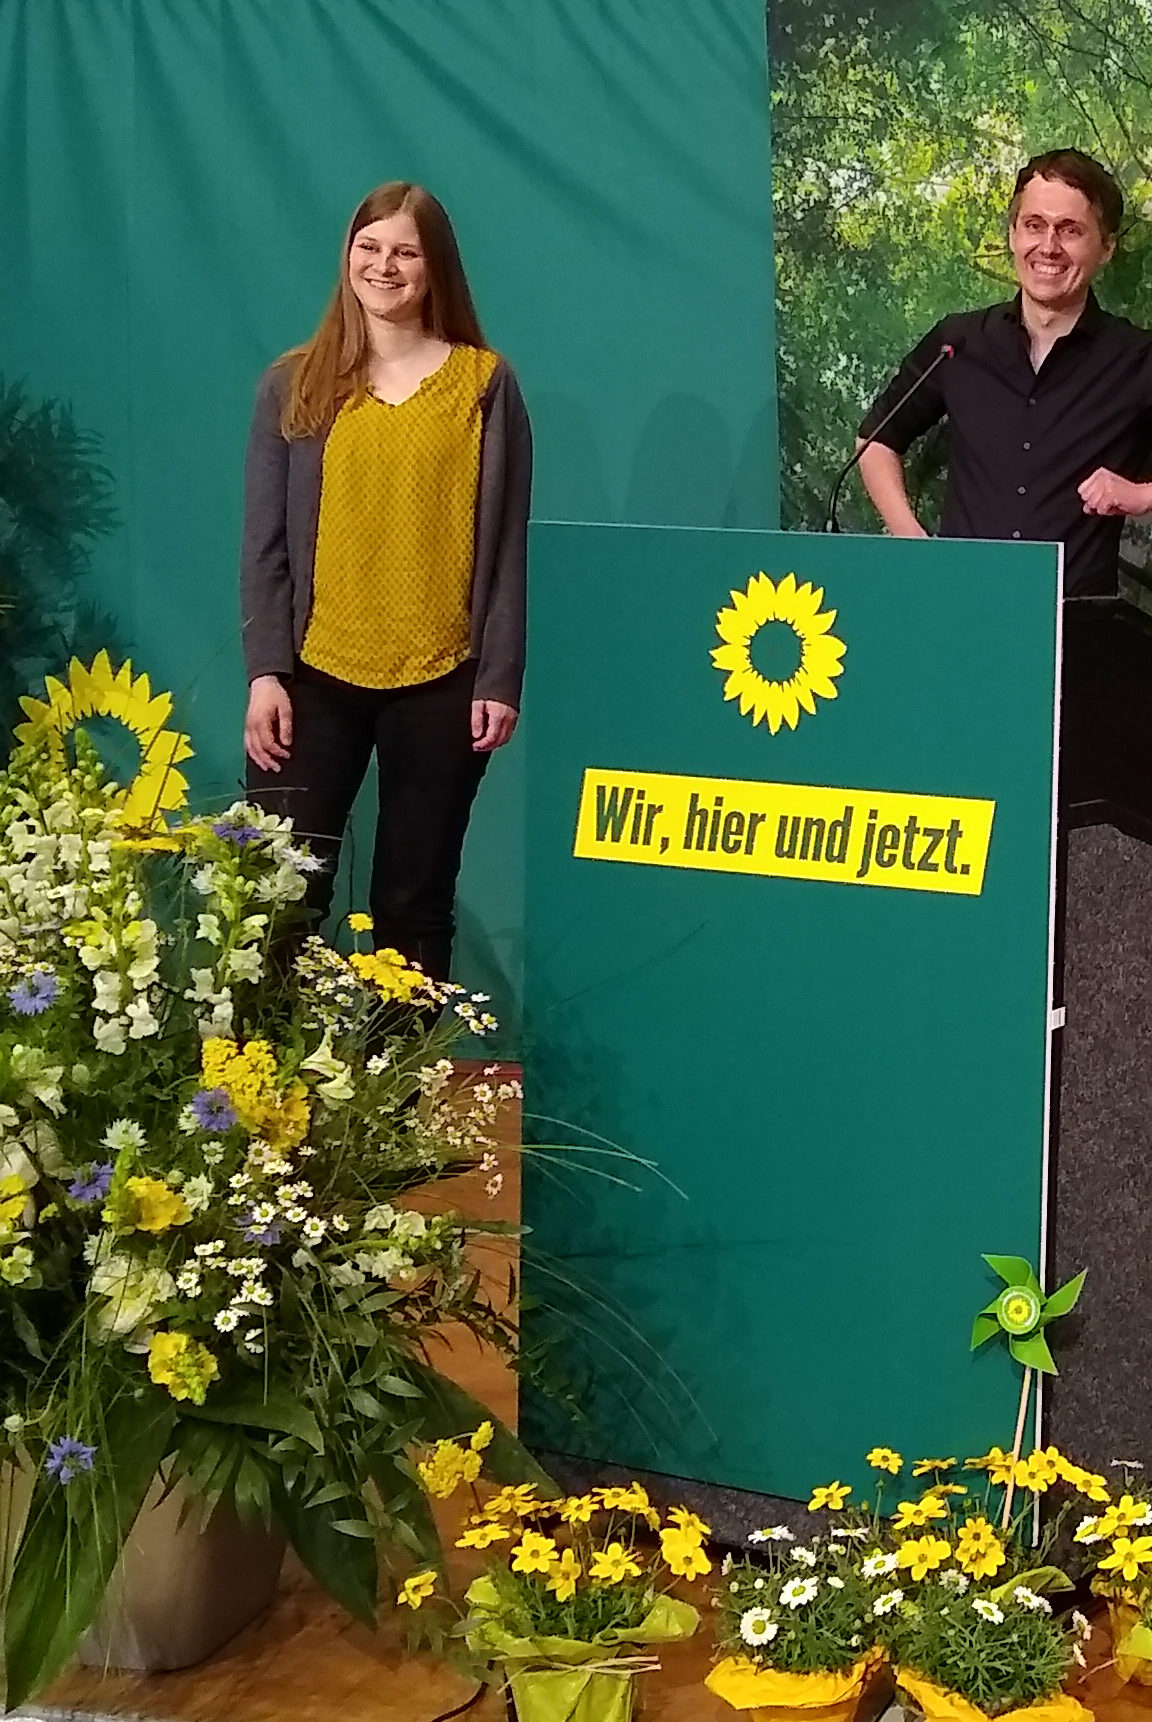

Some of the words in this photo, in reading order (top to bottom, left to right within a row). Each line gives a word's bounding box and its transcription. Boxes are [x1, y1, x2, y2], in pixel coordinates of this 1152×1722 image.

[596, 785, 670, 855] Wir,
[683, 792, 766, 856] hier
[775, 806, 854, 863] und
[856, 809, 971, 878] jetzt.
